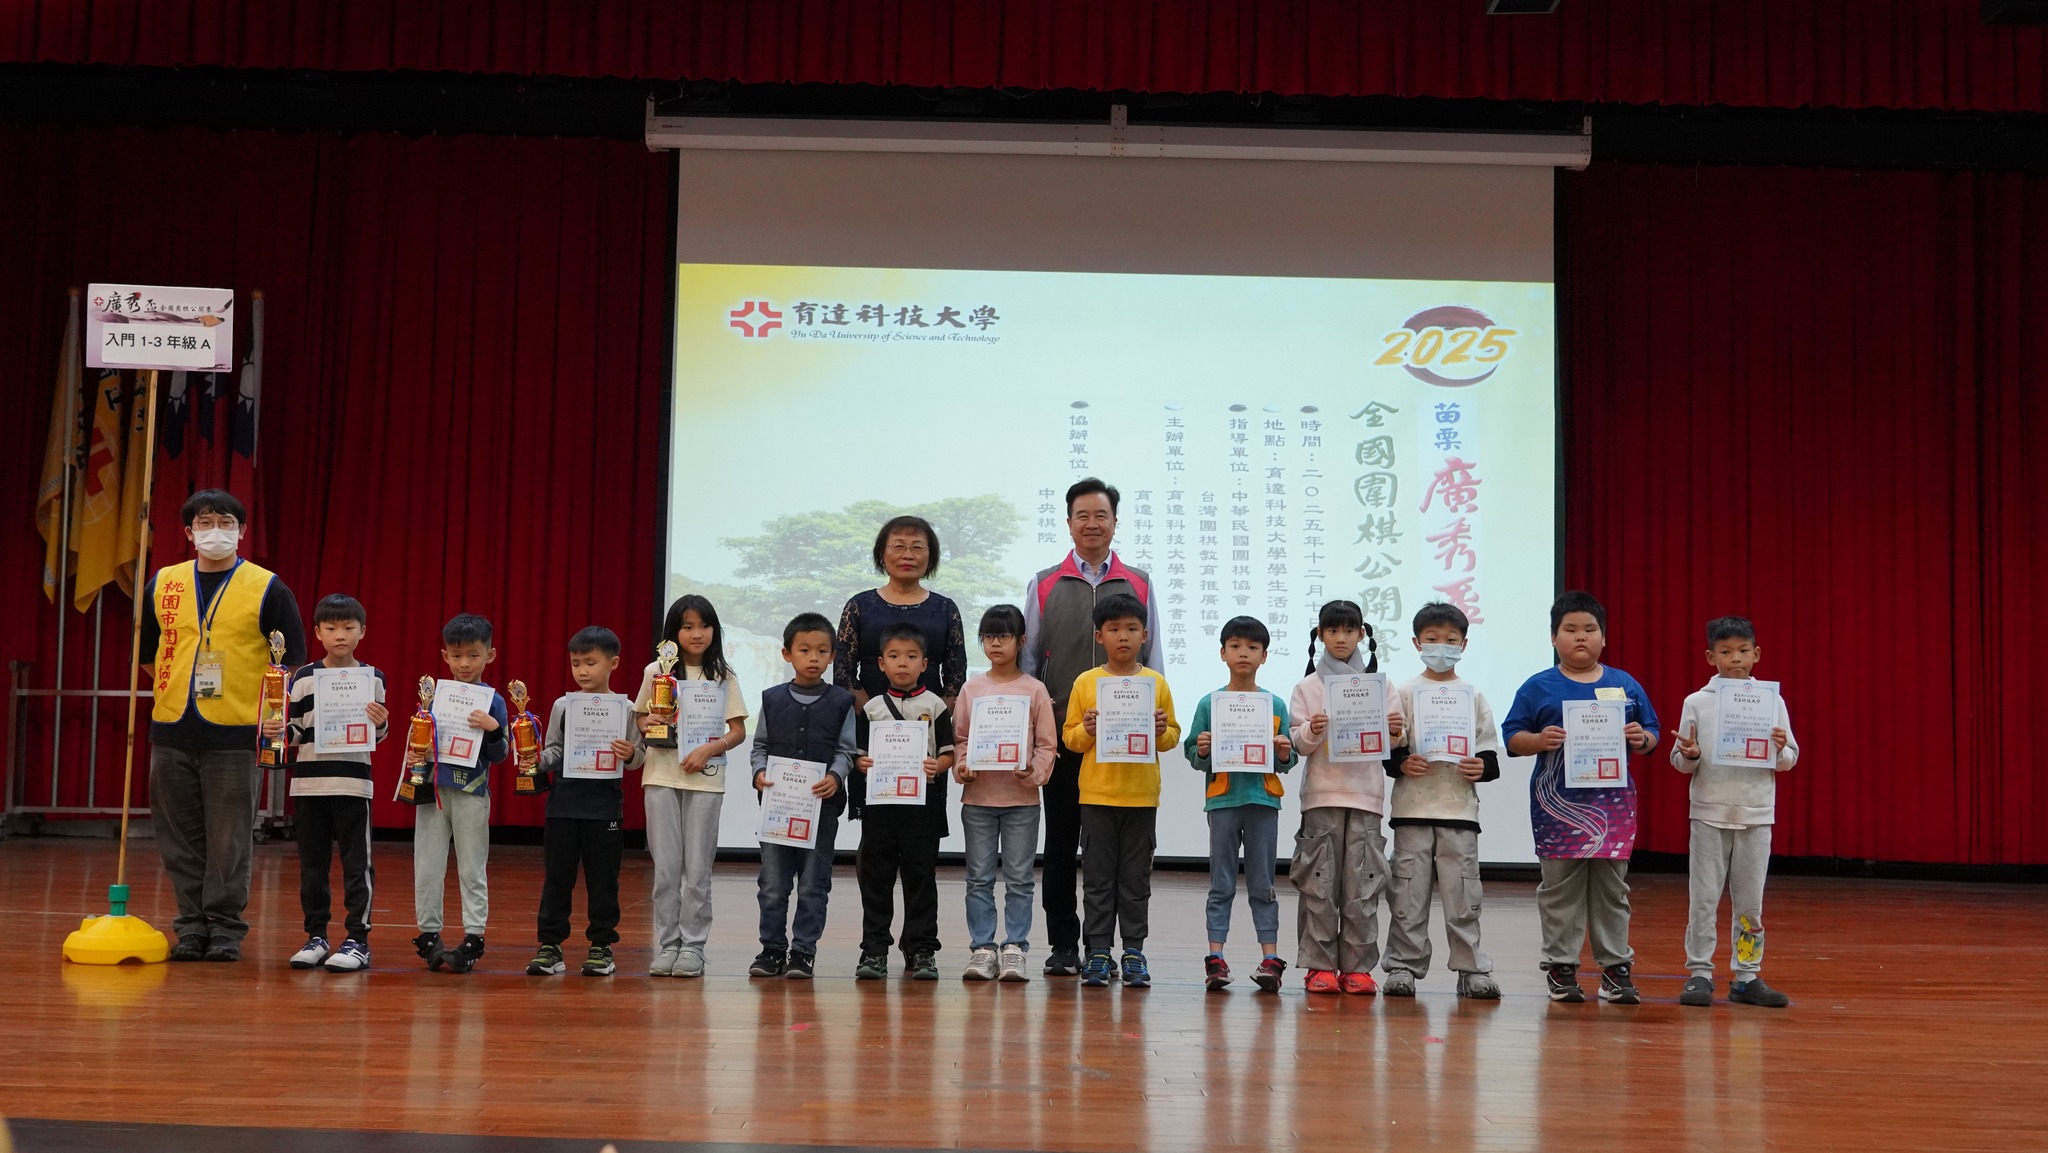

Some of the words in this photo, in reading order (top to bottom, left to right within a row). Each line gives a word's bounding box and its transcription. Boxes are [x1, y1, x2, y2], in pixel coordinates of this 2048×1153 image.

[102, 291, 157, 313] 廣秀盃
[792, 301, 1001, 331] 育達科技大學
[105, 333, 135, 347] 入門
[141, 336, 162, 347] 1-3
[167, 335, 197, 350] 年級
[201, 339, 211, 350] A
[790, 330, 807, 339] Yu
[809, 330, 827, 339] Da
[829, 330, 880, 342] University
[881, 332, 892, 343] of
[892, 331, 927, 341] Science
[929, 333, 946, 342] and
[947, 333, 1001, 344] Technology
[1374, 329, 1519, 366] 2025
[1434, 402, 1462, 451] 苗栗
[1037, 487, 1057, 544] 中央棋院
